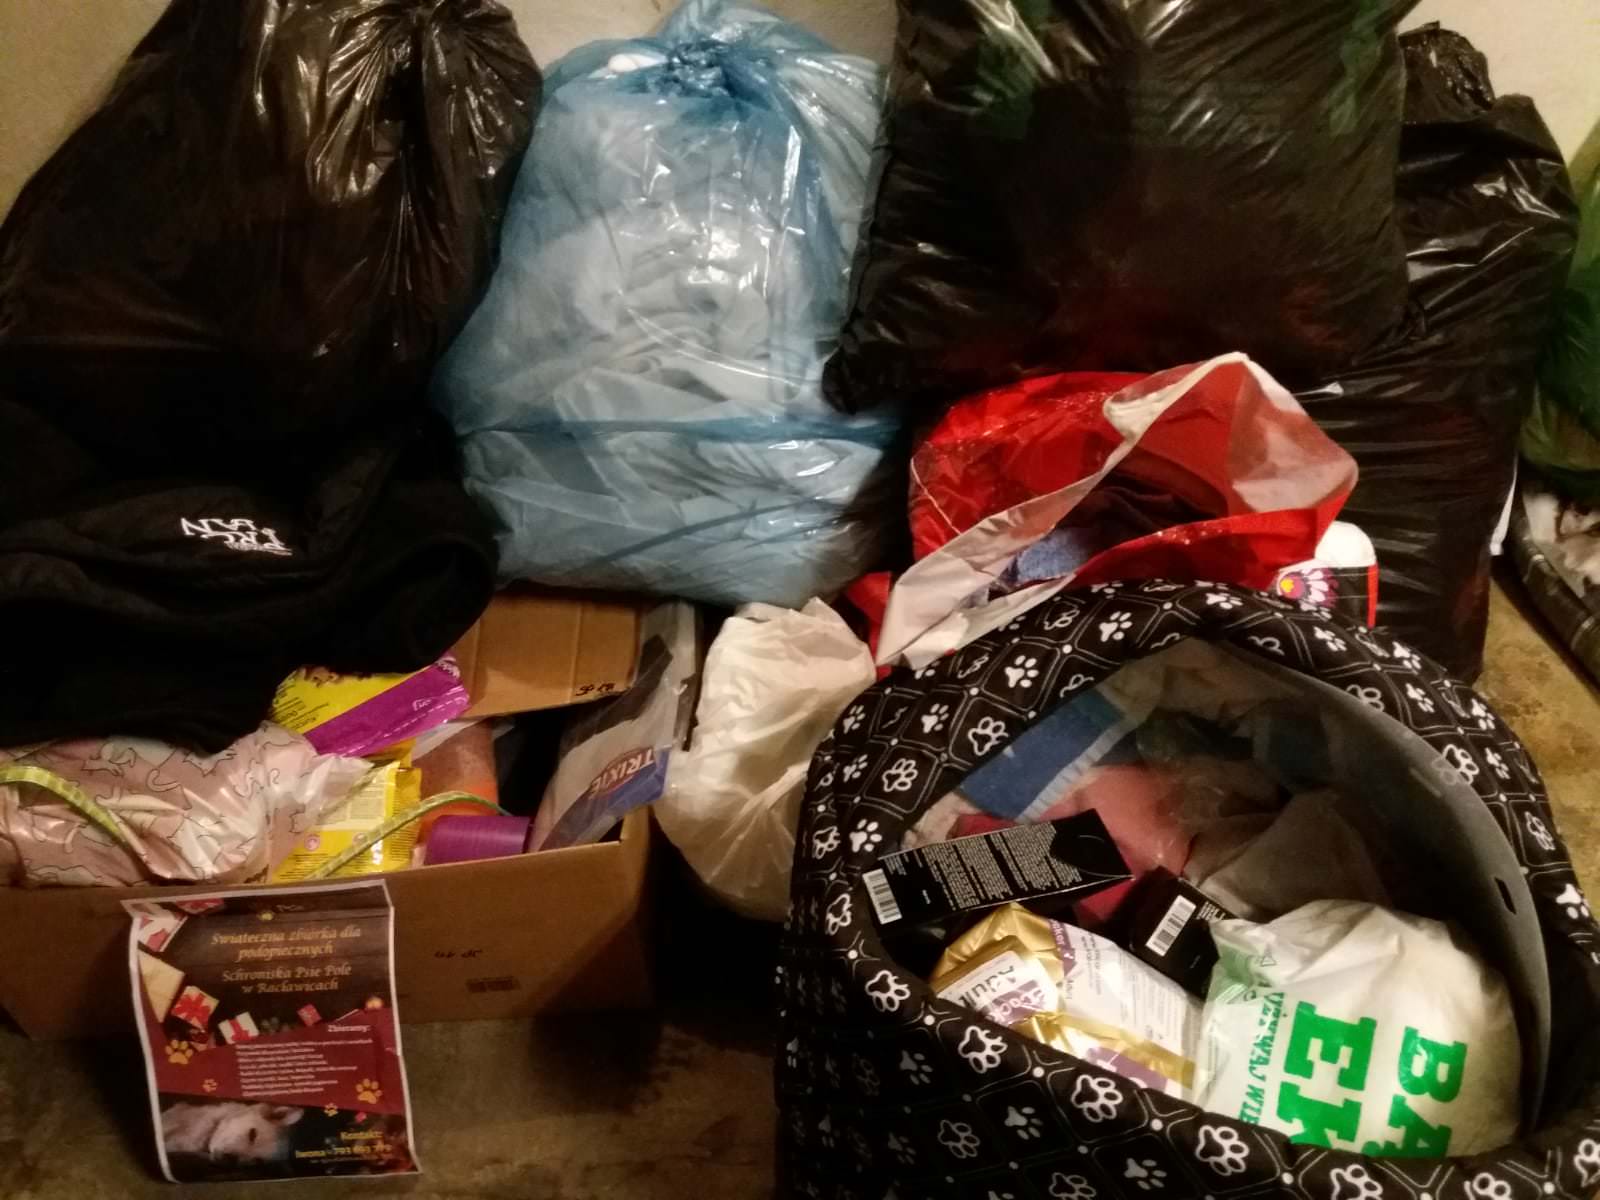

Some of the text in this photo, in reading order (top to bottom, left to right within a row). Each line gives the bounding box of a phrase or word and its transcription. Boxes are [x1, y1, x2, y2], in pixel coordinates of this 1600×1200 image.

[591, 749, 655, 795] TRIXIE
[340, 924, 362, 938] dla
[324, 961, 353, 976] Pole
